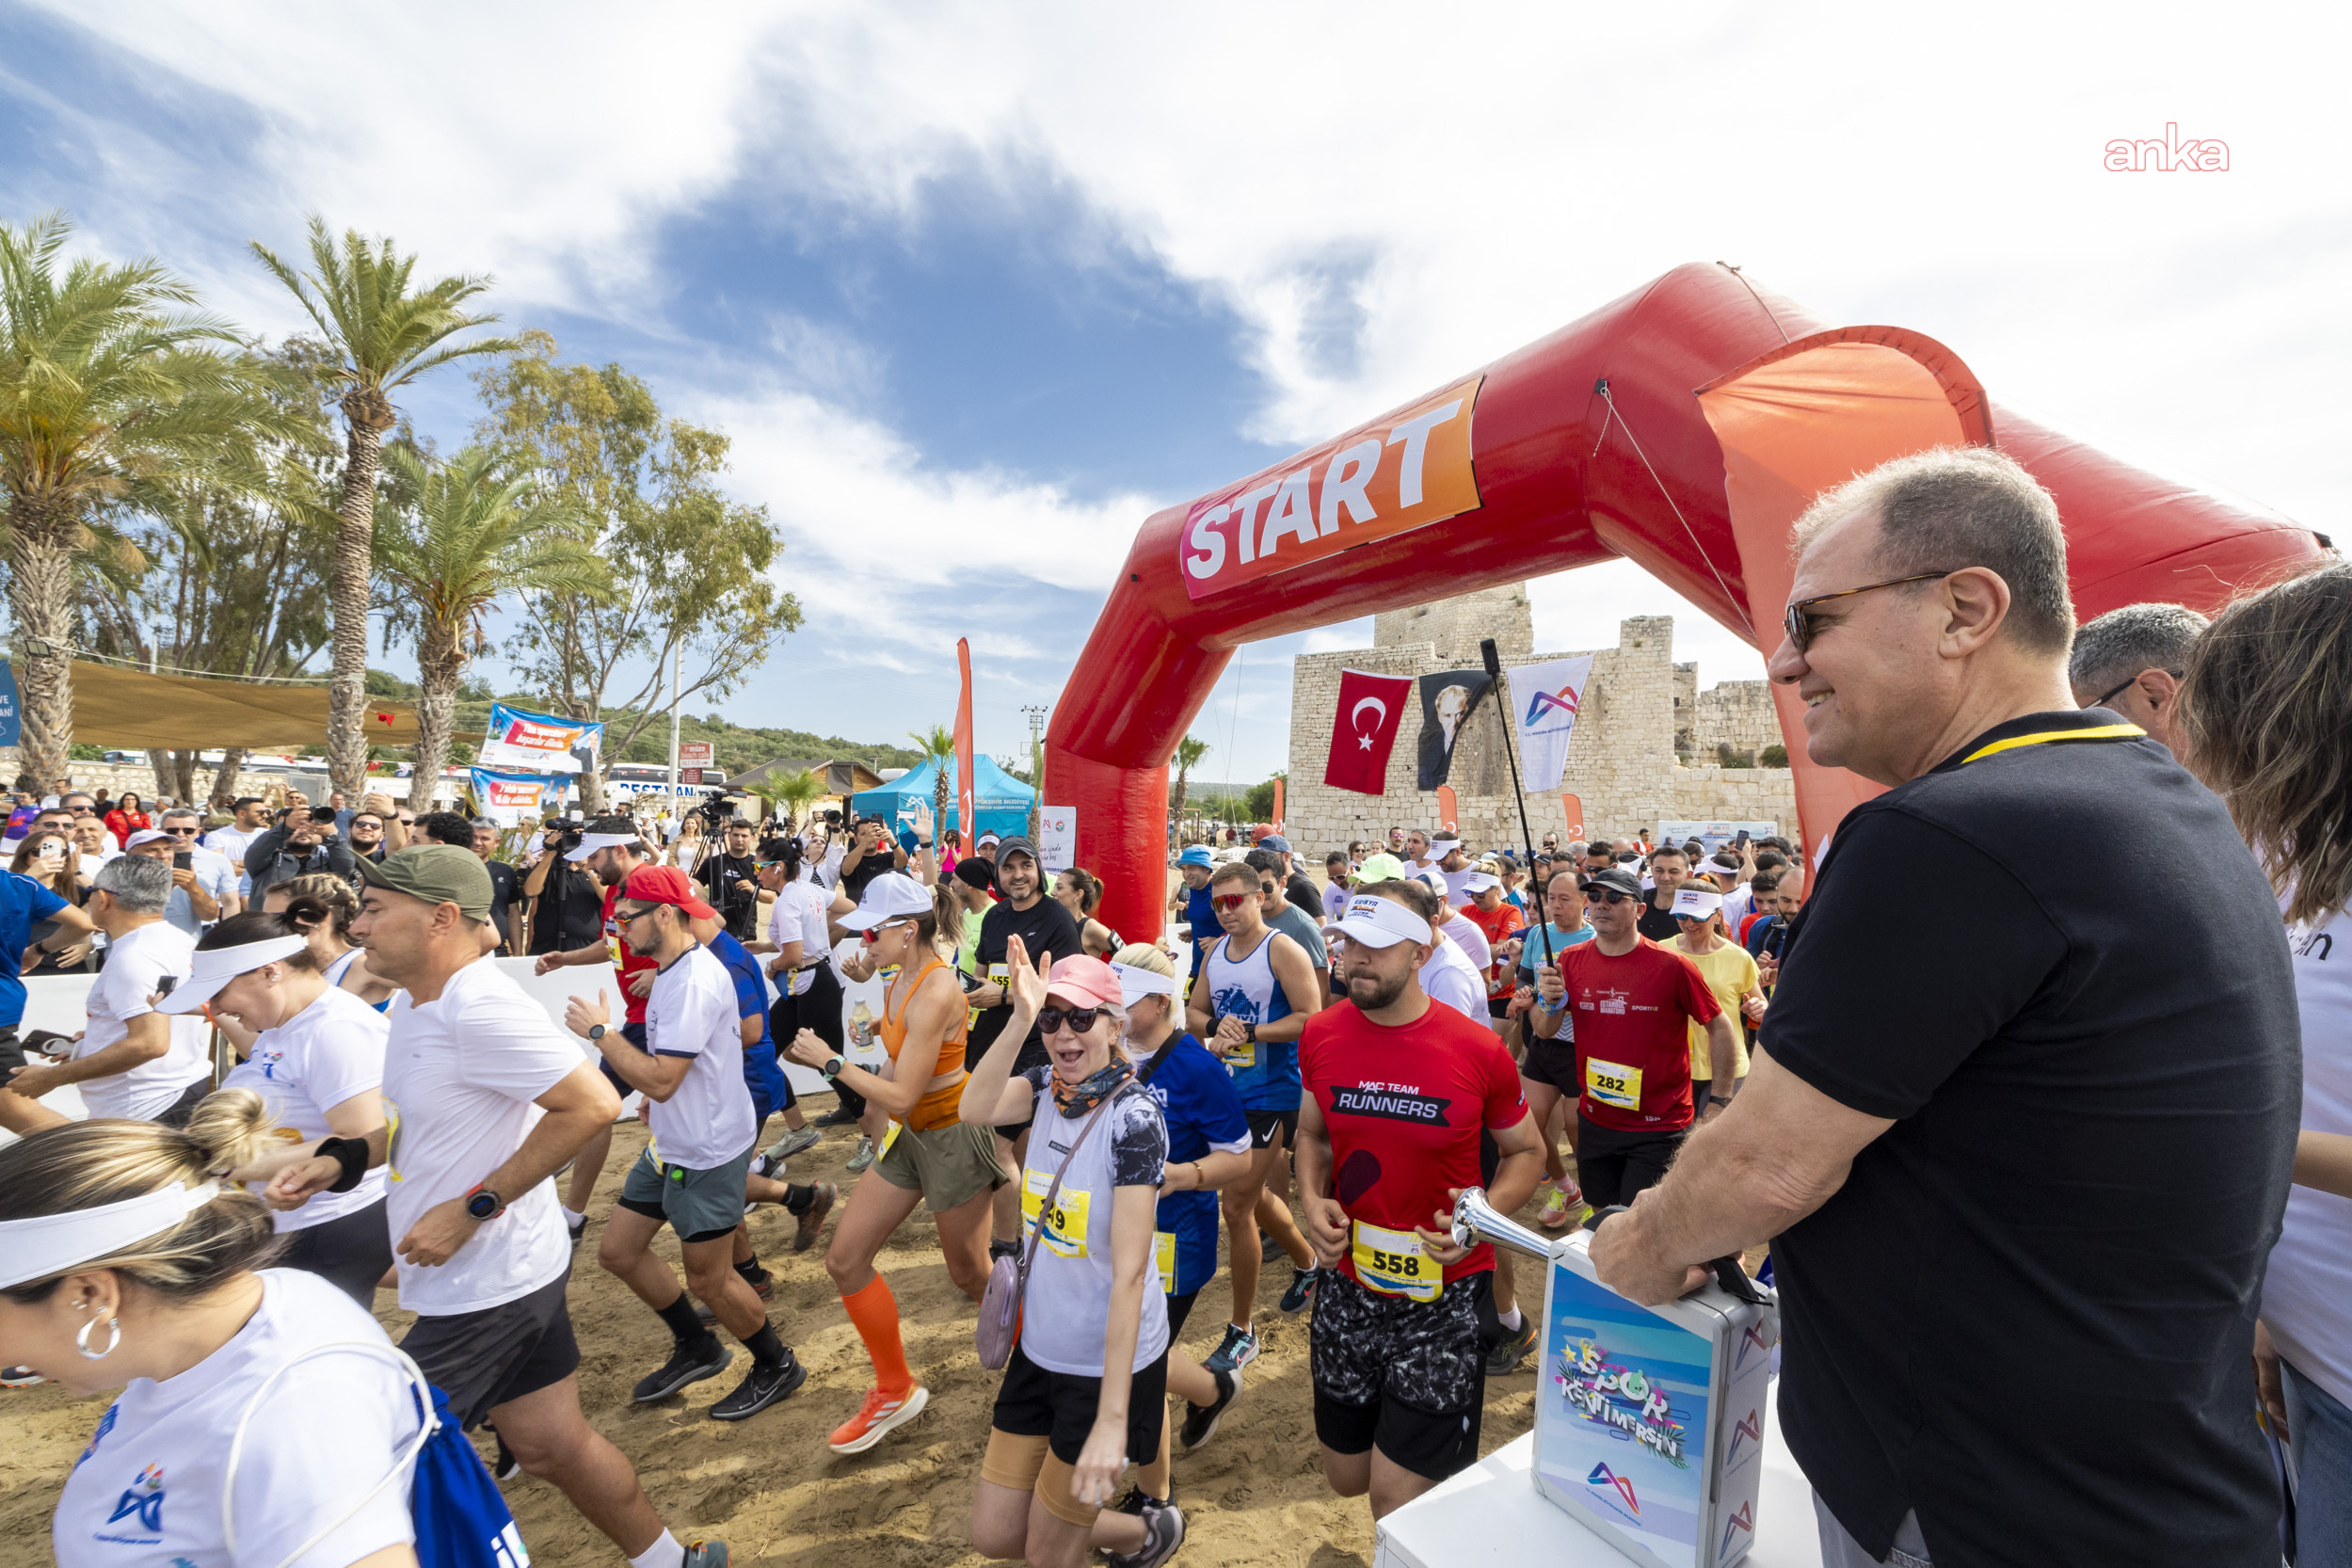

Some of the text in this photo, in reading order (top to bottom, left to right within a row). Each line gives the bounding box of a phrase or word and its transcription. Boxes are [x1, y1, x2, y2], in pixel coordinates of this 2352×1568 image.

[1187, 398, 1464, 579] START
[1358, 1080, 1419, 1096] MAC TEAM
[1596, 1074, 1624, 1093] 282
[1338, 1093, 1438, 1119] RUNNERS
[1372, 1250, 1419, 1276] 558
[1577, 1349, 1668, 1422] SPOR
